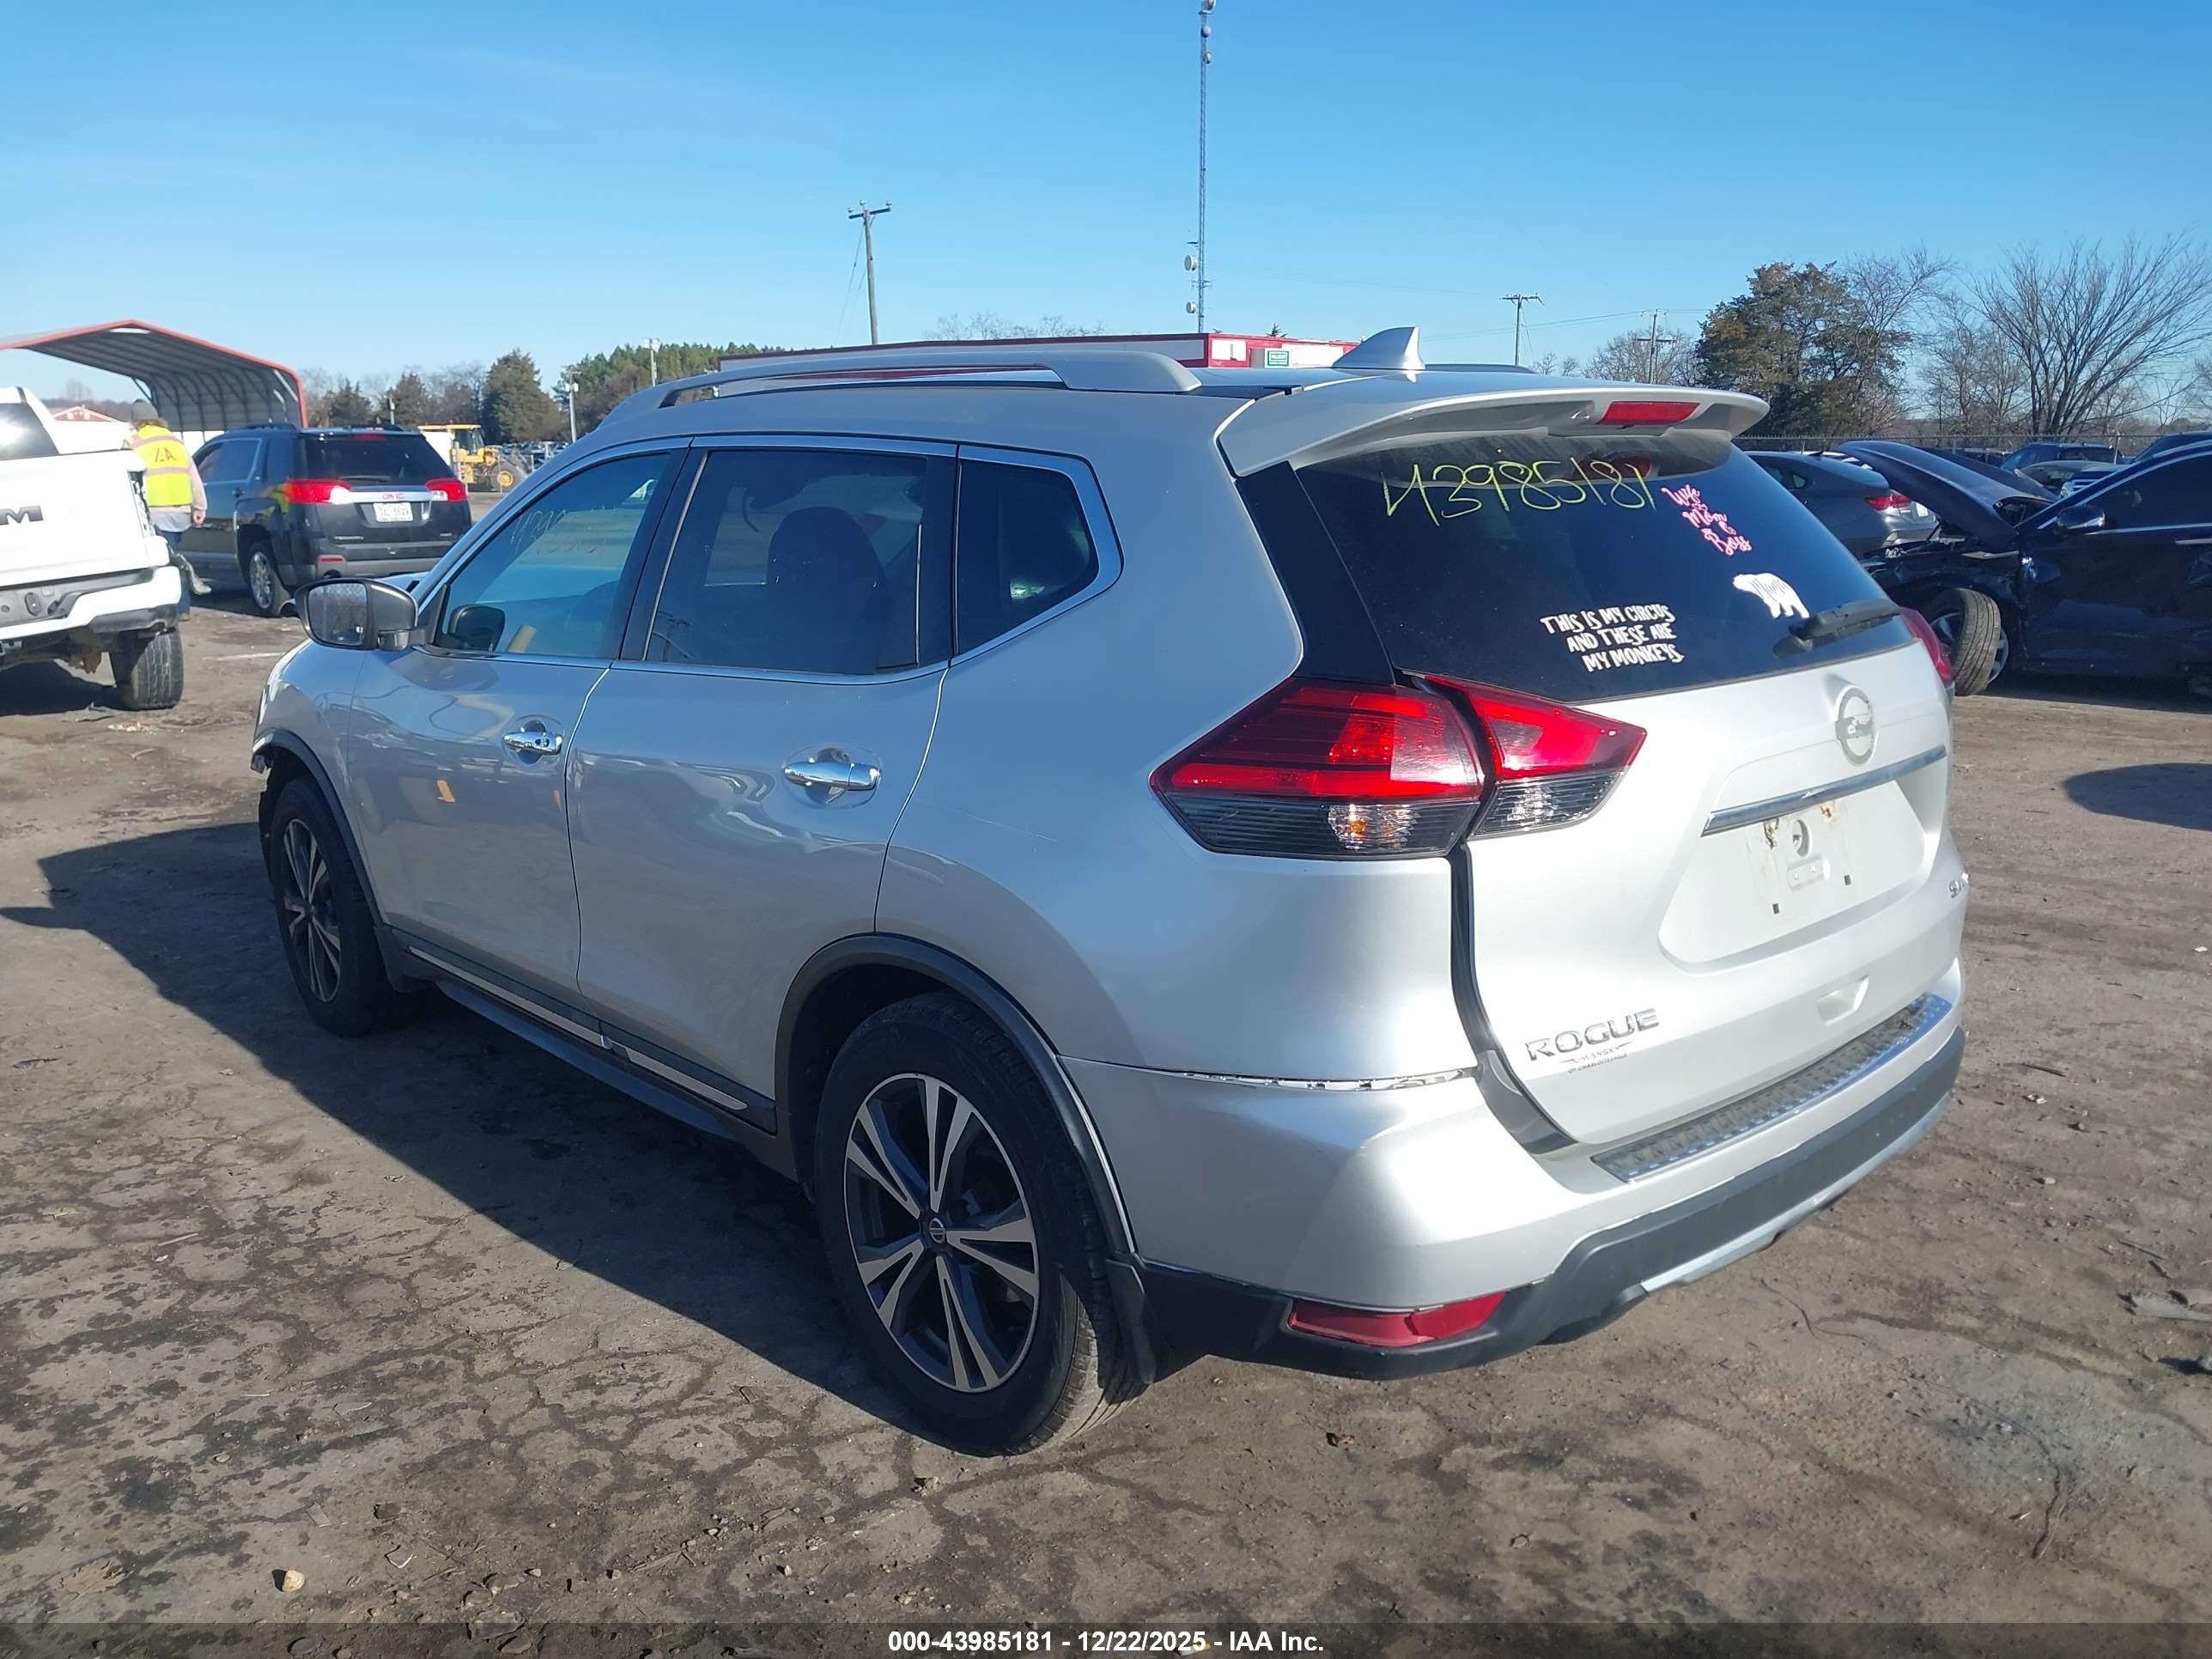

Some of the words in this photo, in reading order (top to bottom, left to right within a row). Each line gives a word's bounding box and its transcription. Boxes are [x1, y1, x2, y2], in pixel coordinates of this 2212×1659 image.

[1380, 457, 1656, 527] 43985181
[1540, 613, 1585, 634] THIS
[1580, 611, 1602, 629] IS
[1598, 606, 1626, 625] MY
[1624, 604, 1676, 623] CIRCUS
[1566, 632, 1599, 653] AND
[1597, 624, 1650, 646] THESE
[1649, 623, 1677, 640] ARE
[1582, 652, 1612, 672] MY
[1525, 1008, 1660, 1061] ROGUE
